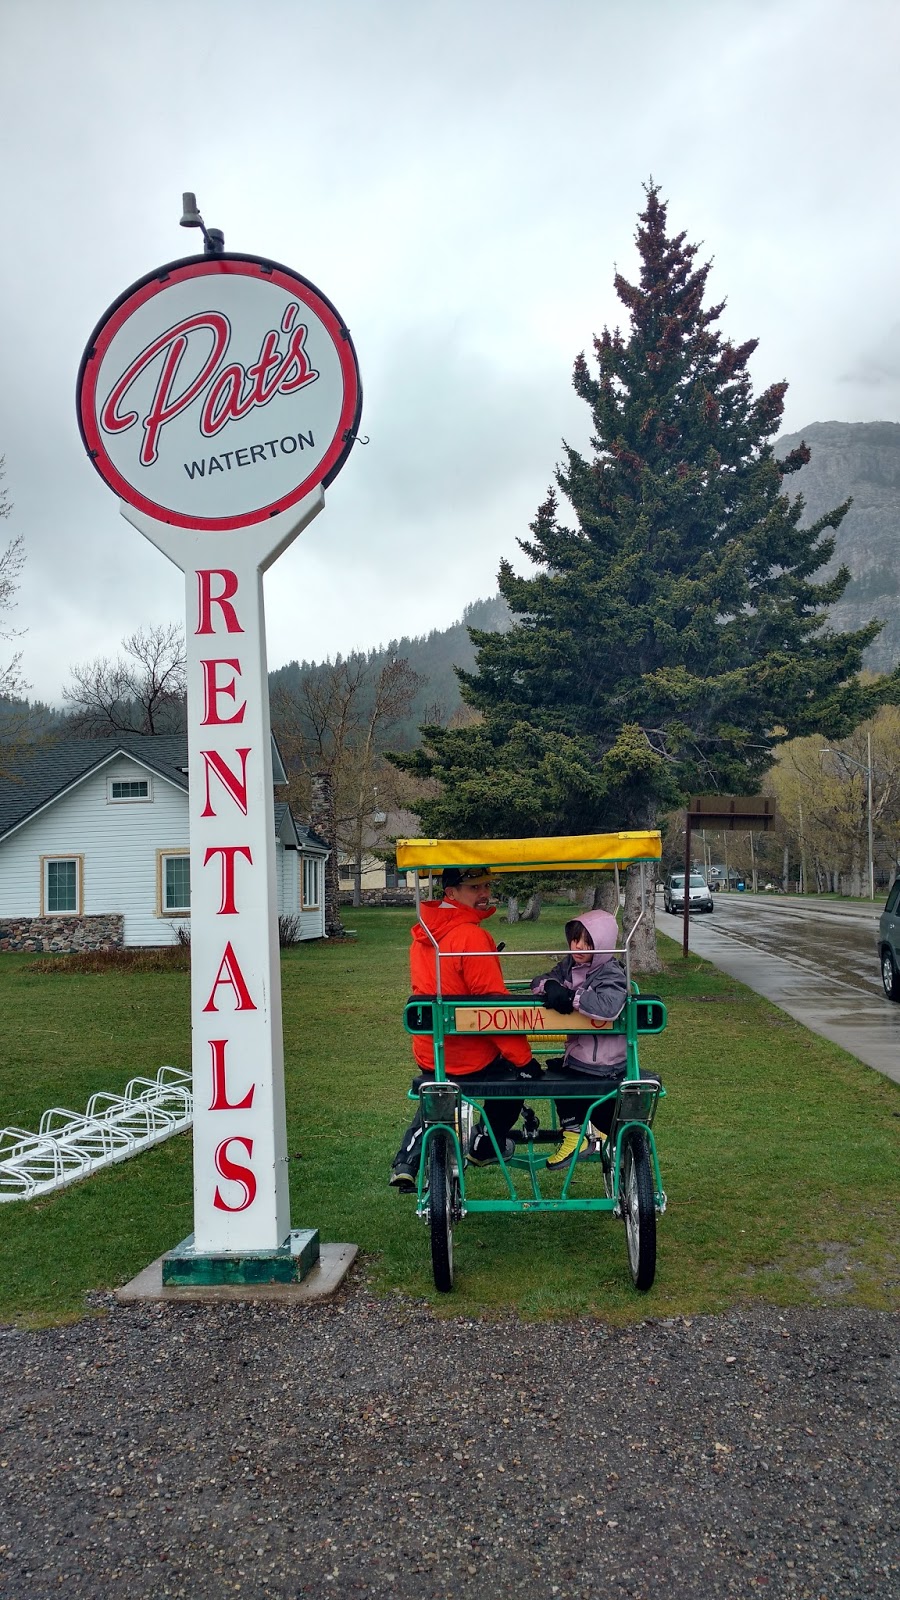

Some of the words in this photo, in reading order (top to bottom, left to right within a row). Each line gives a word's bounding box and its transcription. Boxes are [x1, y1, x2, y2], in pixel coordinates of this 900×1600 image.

[100, 302, 319, 467] Pat's
[184, 430, 316, 480] WATERTON
[195, 569, 257, 1213] RENTALS
[478, 1009, 545, 1031] DONNA
